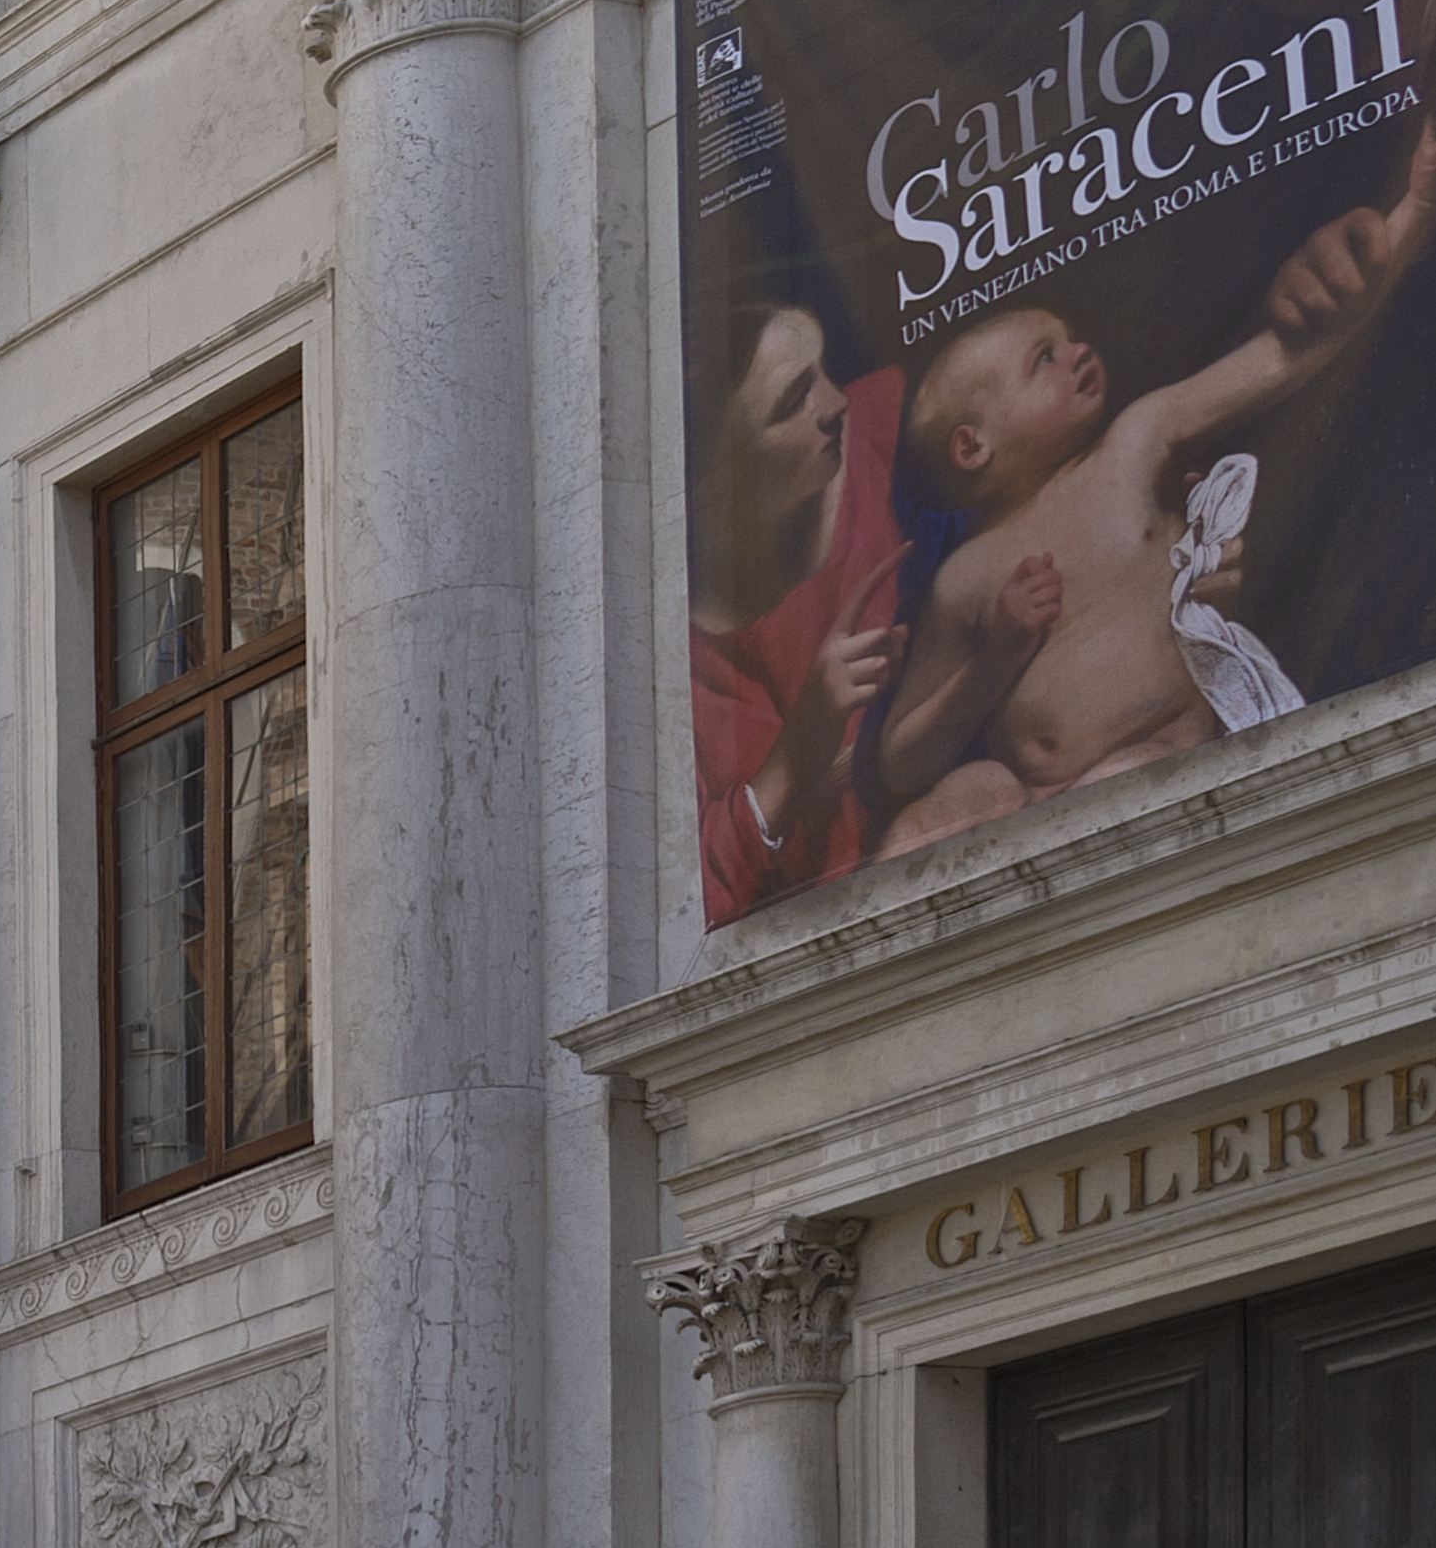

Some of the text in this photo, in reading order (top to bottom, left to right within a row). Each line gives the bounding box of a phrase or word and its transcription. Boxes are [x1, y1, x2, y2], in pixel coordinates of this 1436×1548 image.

[866, 9, 1170, 223] Carlo
[898, 84, 1420, 346] UN VENEZIANO TRA ROMA E L'EUROPA
